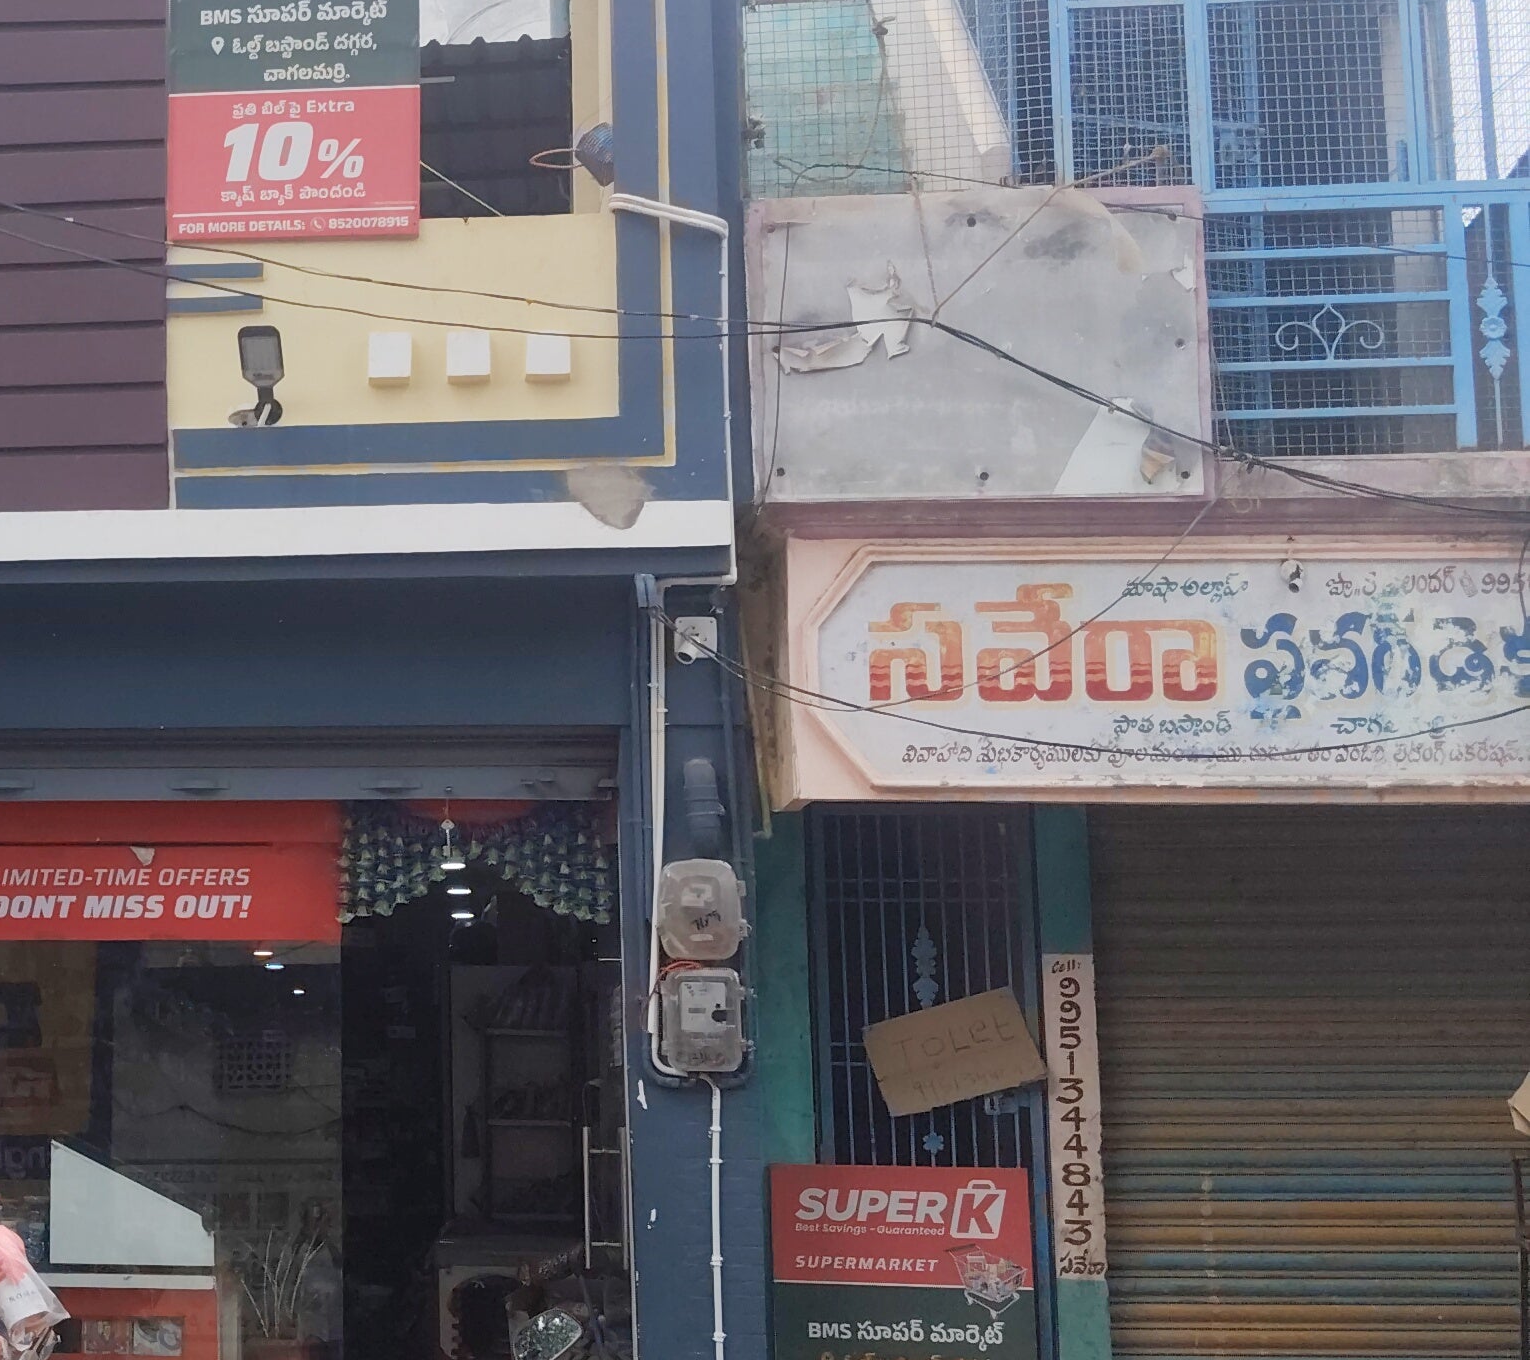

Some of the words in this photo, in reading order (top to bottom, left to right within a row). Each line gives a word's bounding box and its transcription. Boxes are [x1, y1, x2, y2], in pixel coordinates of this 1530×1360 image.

[200, 10, 241, 25] BMS
[247, 0, 311, 23] సూపర్
[307, 100, 355, 113] Extra
[224, 122, 364, 181] 10%
[179, 223, 204, 234] FOR
[208, 221, 245, 233] MORE
[158, 868, 250, 886] OFFERS
[82, 896, 164, 919] MISS
[174, 896, 252, 919] OUT!
[794, 1187, 948, 1224] SUPER
[795, 1255, 939, 1272] SUPERMARKET
[808, 1322, 851, 1339] BMS
[857, 1319, 924, 1342] సూపర్
